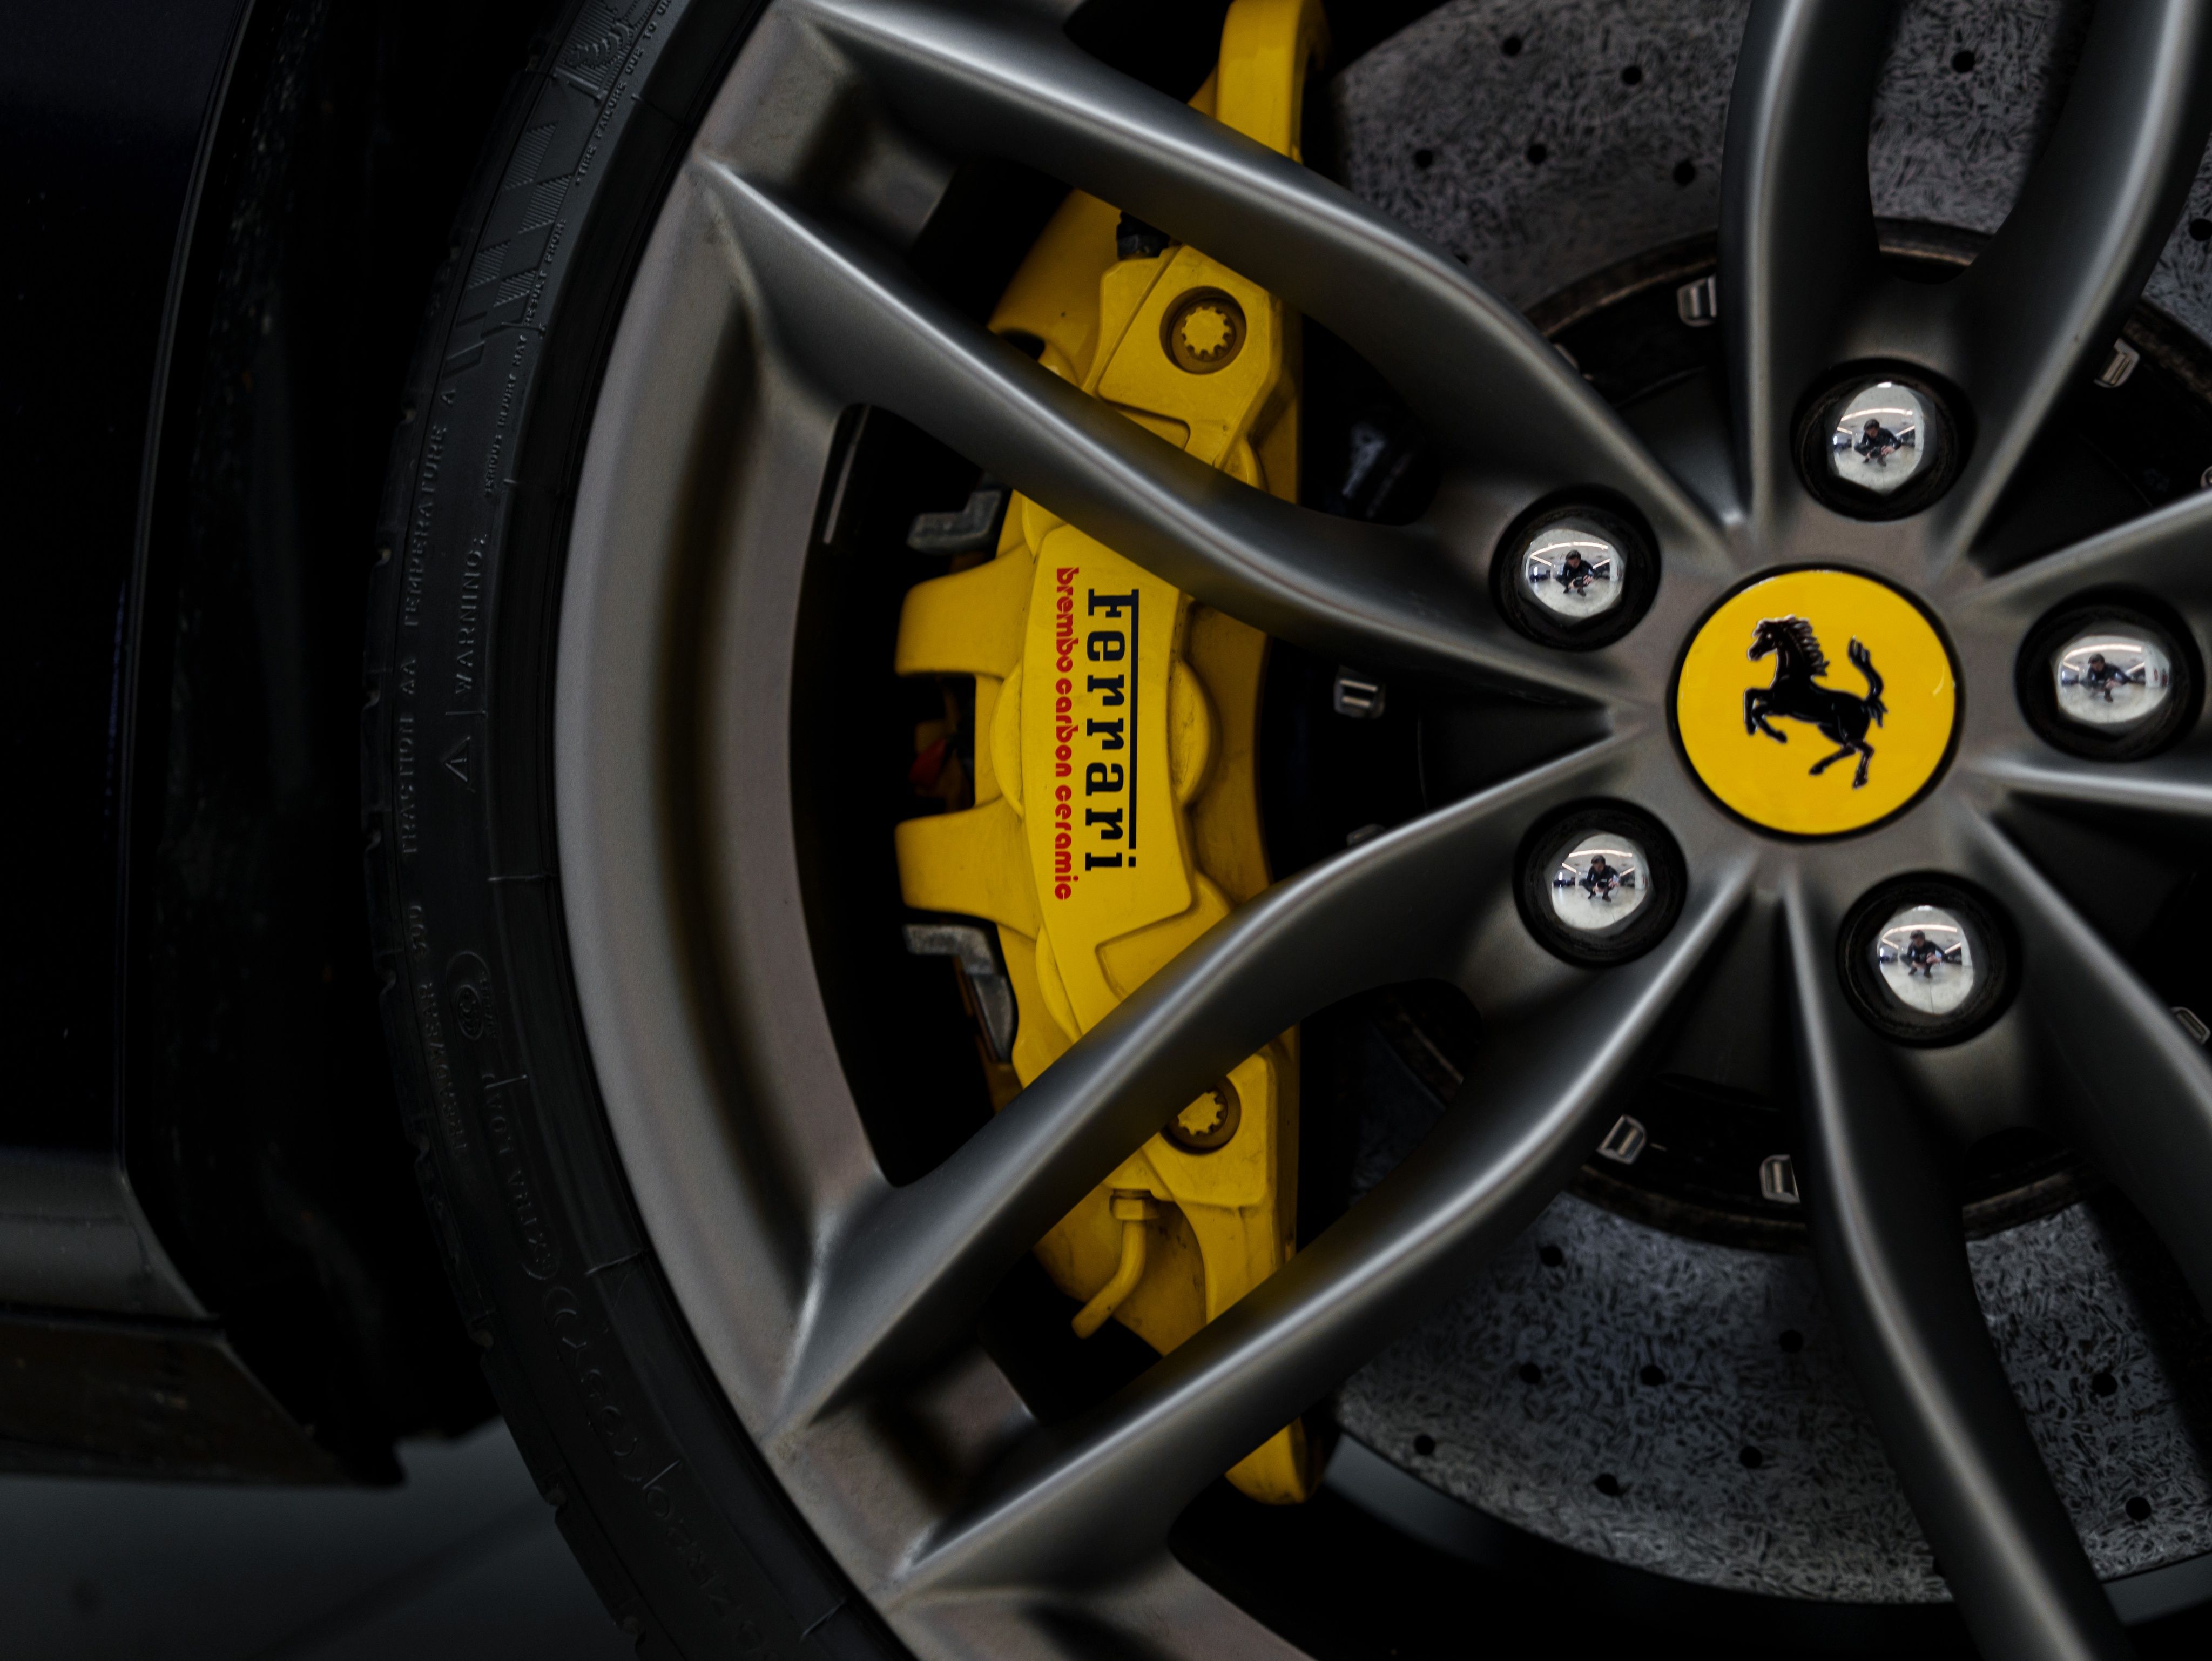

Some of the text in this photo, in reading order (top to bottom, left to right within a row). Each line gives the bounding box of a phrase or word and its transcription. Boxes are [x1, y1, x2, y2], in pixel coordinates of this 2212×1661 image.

[642, 21, 657, 41] TO
[440, 389, 457, 405] A
[404, 424, 447, 627] TEMPERATURE
[400, 660, 417, 695] AA
[1055, 567, 1080, 900] brembo carbon ceramic
[1085, 588, 1139, 871] Ferrari
[399, 716, 415, 855] TRACTION
